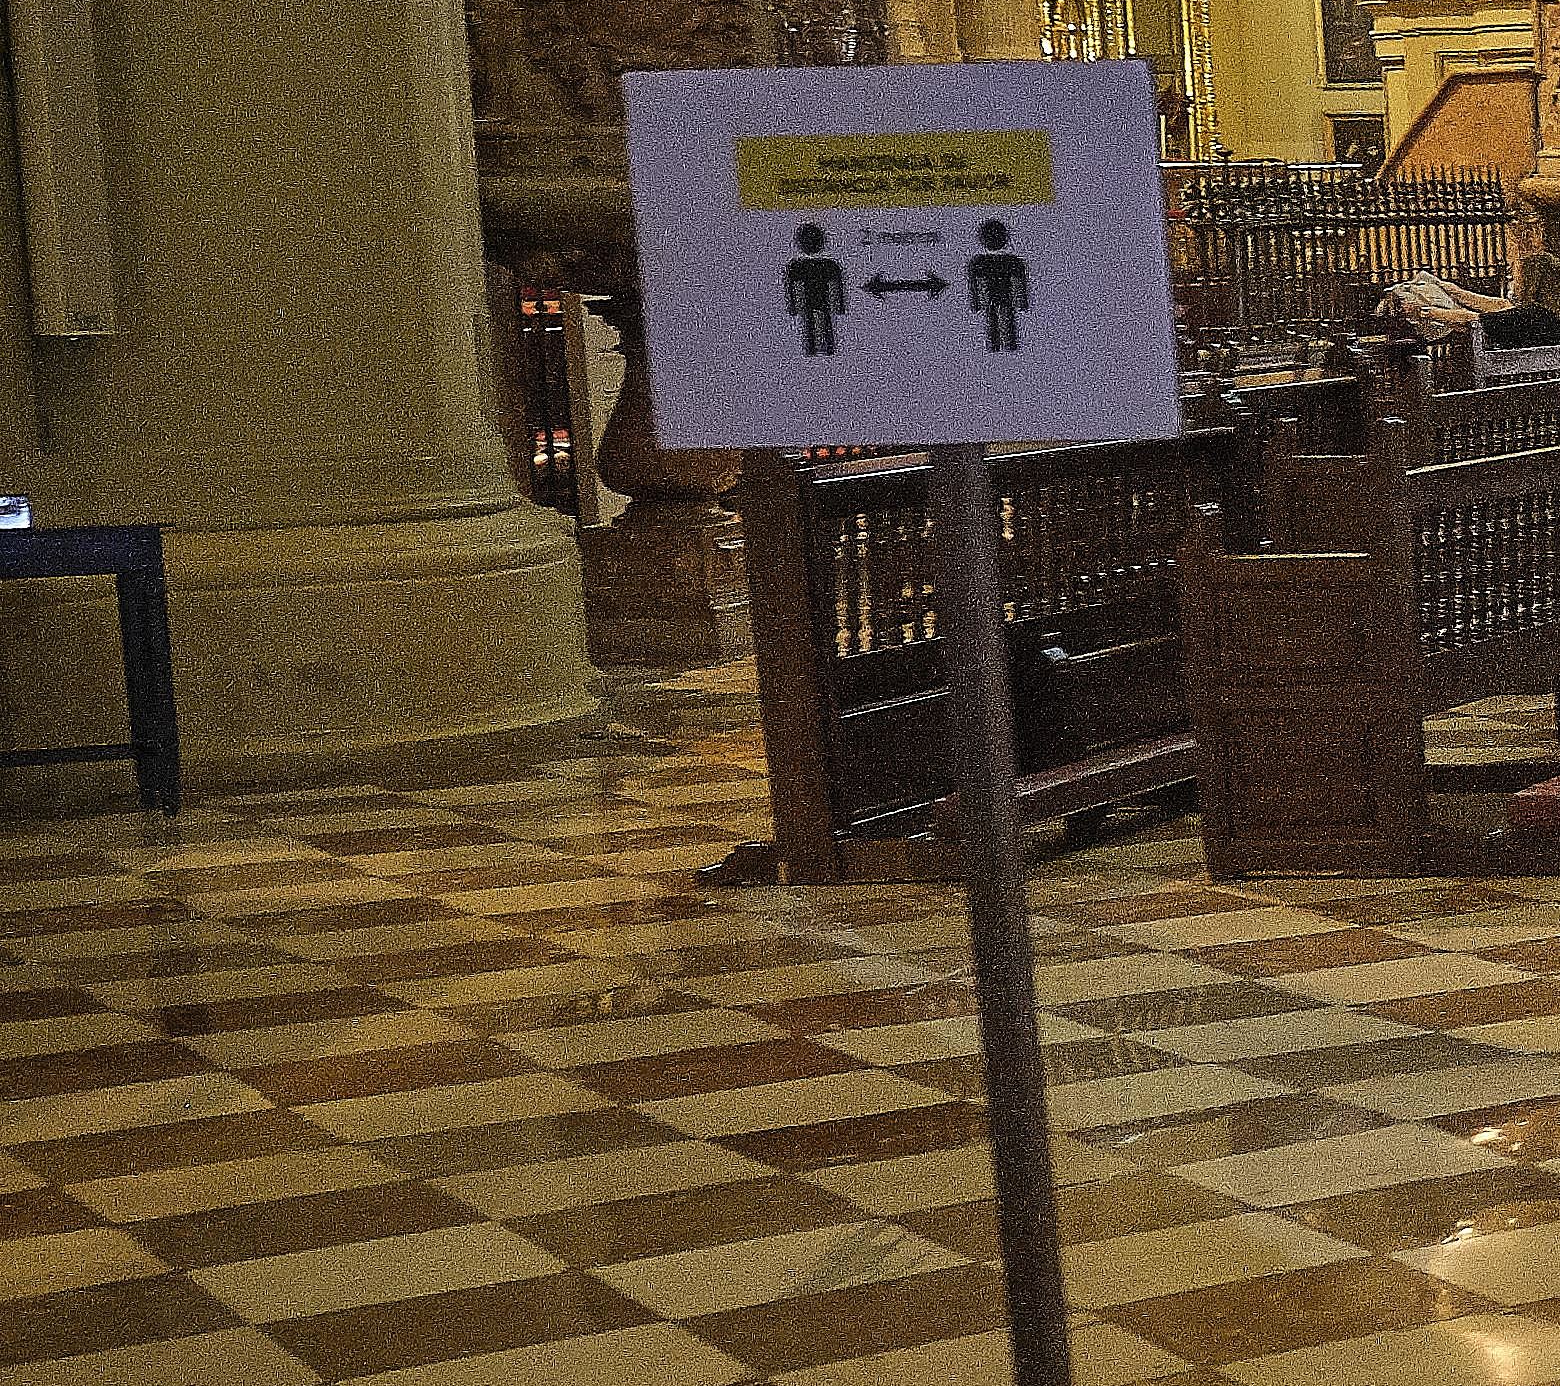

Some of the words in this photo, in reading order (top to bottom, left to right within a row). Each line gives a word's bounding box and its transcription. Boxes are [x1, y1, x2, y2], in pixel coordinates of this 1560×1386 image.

[780, 176, 888, 194] DISTANCIA
[894, 174, 935, 191] POR
[941, 173, 1009, 190] FAVOR
[859, 228, 873, 246] 2
